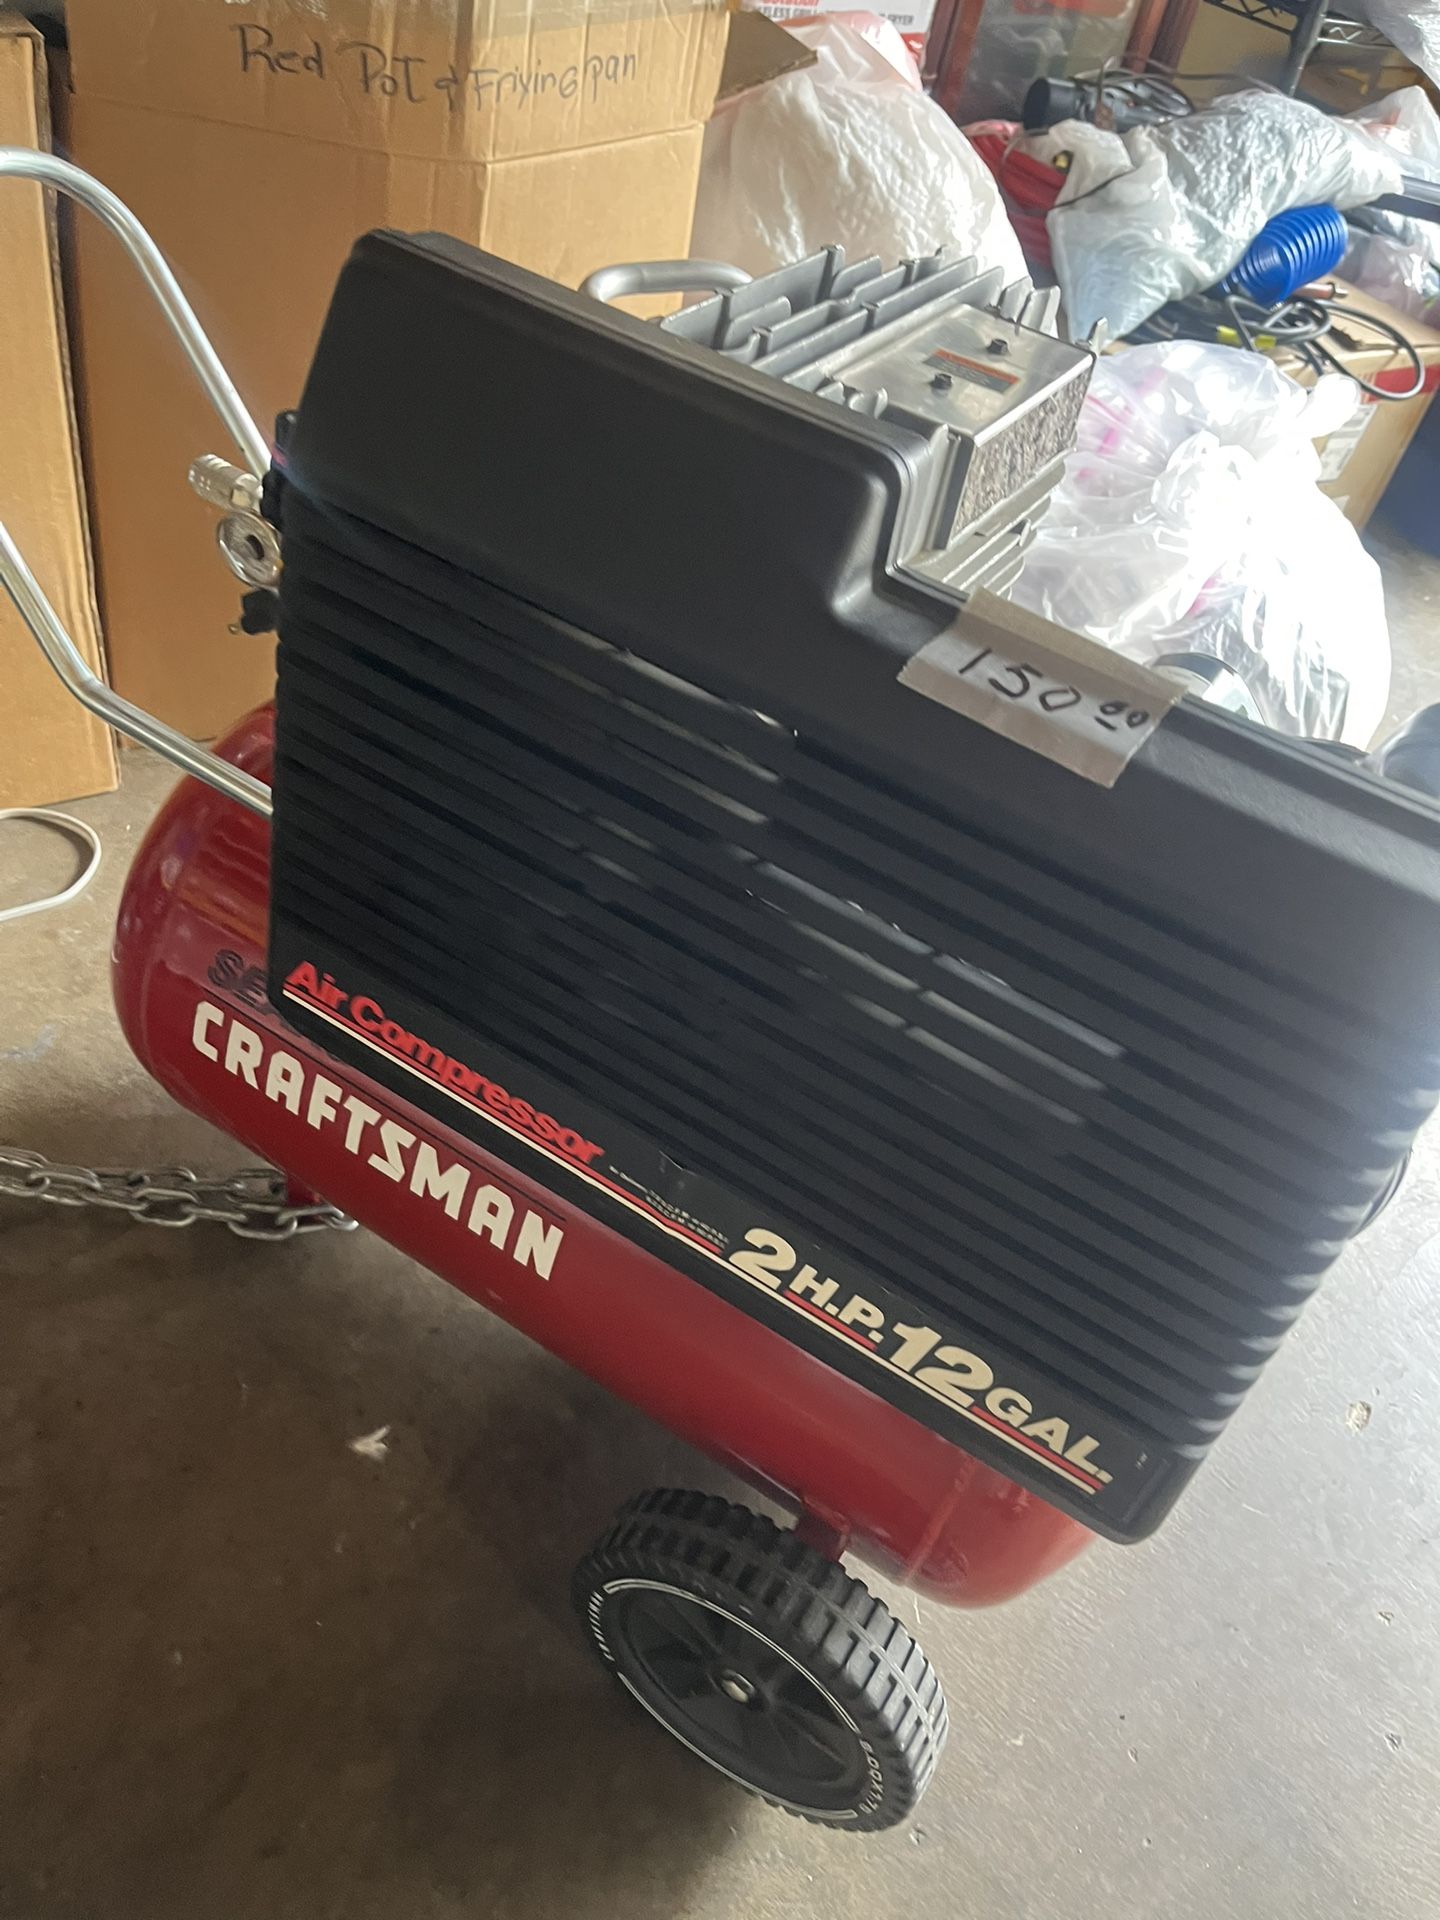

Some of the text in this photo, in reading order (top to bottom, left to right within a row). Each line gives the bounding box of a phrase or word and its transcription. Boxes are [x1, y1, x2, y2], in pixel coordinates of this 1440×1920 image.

[230, 23, 325, 80] Red
[192, 1000, 565, 1281] CRAFTSMAN
[283, 960, 605, 1164] Air Compressor
[728, 1227, 1114, 1484] 2 H.P. 12 GAL.
